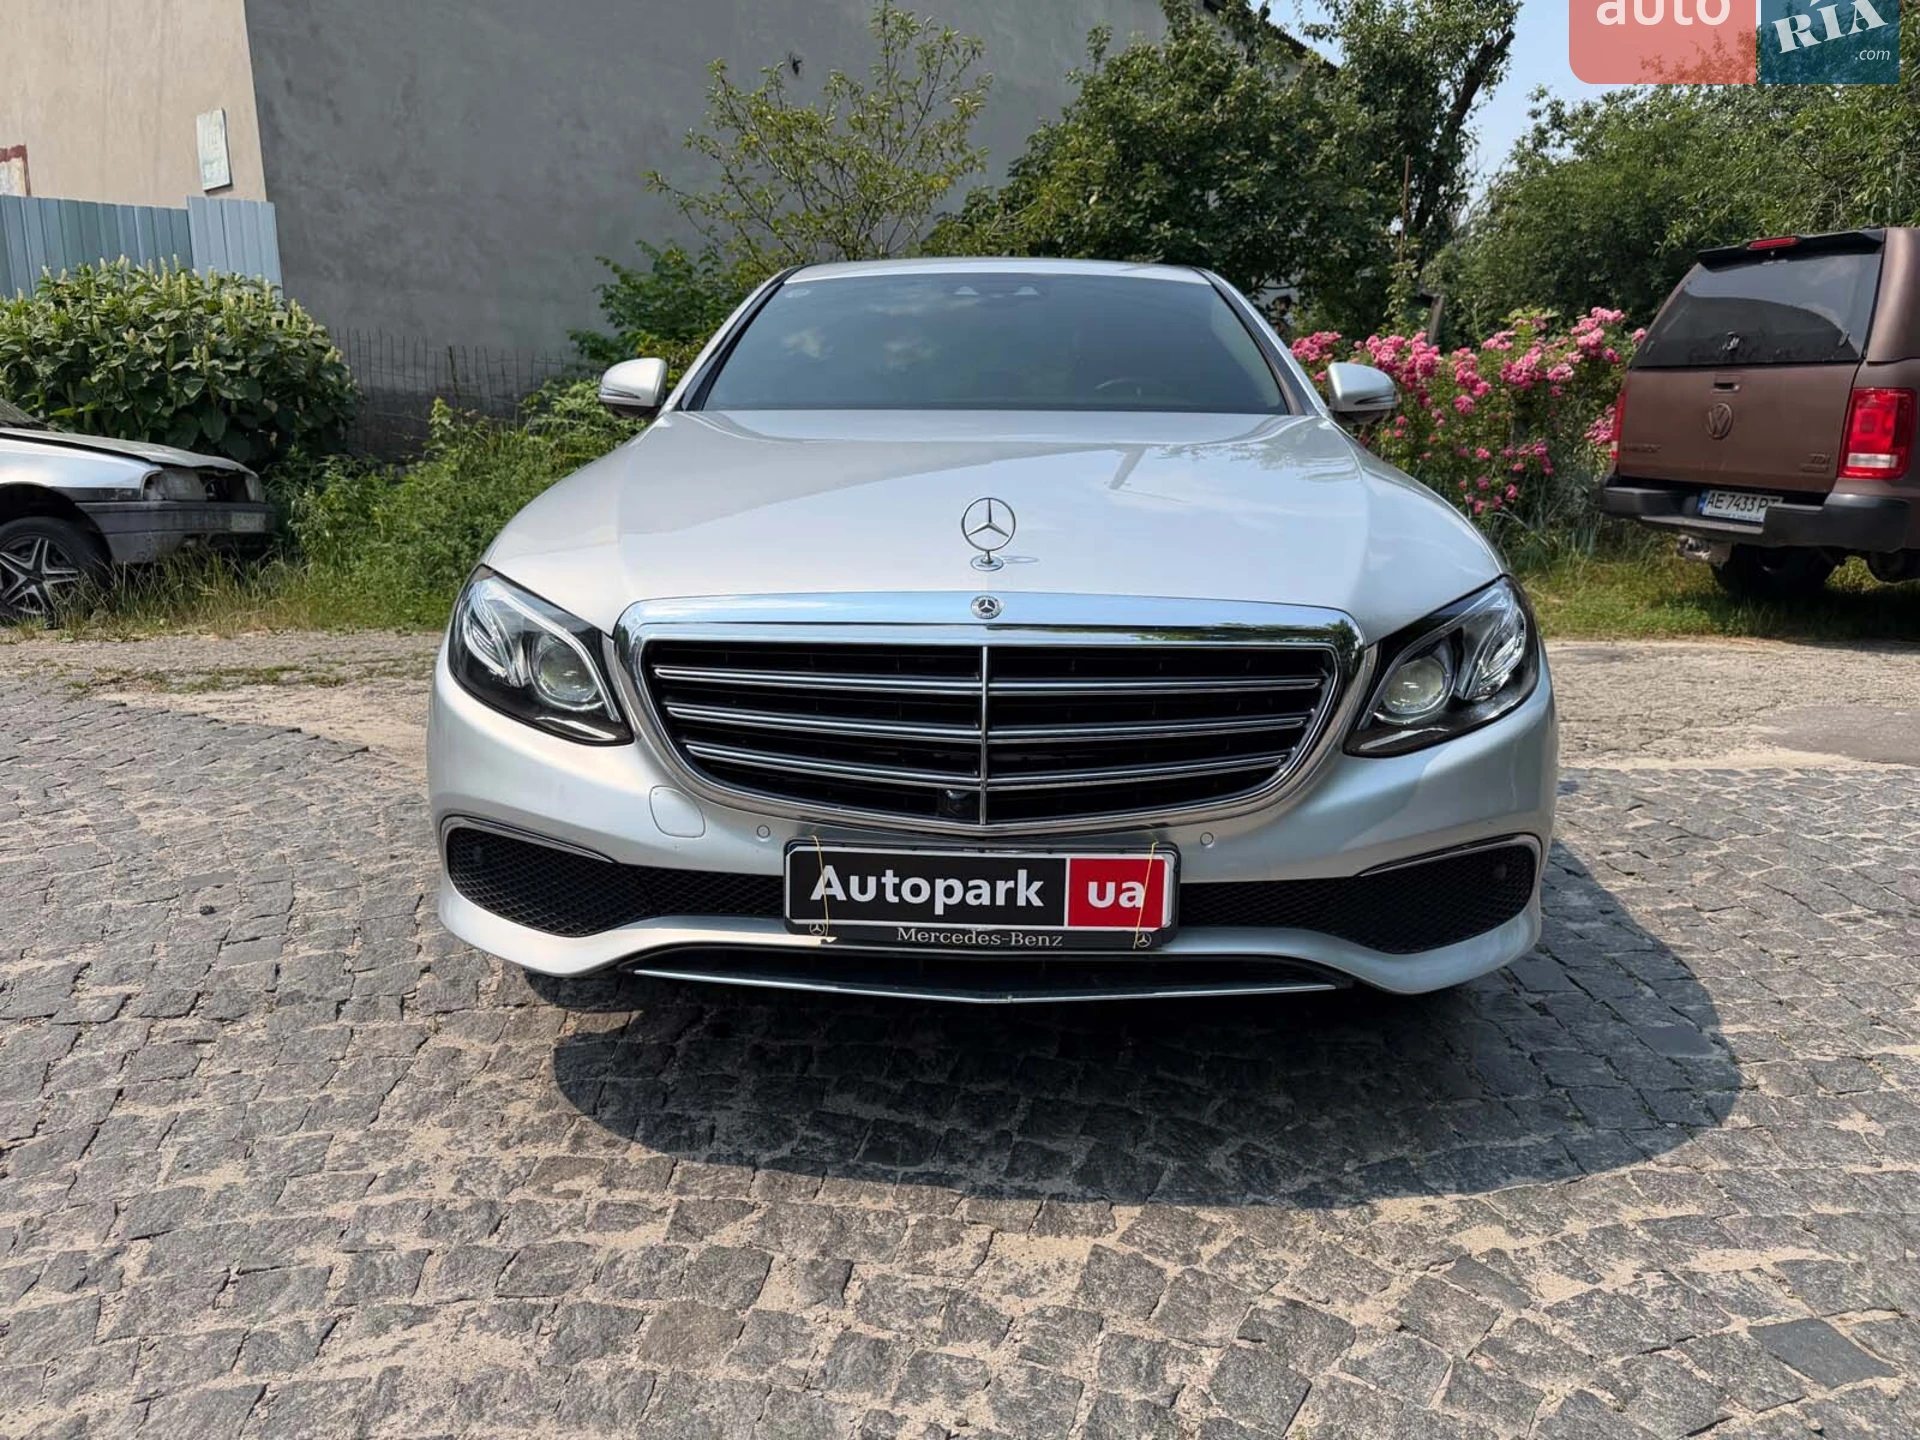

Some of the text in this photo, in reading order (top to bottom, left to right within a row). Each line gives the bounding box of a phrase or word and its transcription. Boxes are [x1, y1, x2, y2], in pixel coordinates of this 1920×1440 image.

[810, 864, 1145, 916] Autopark ua
[896, 927, 1063, 947] Mercedes-Benz
